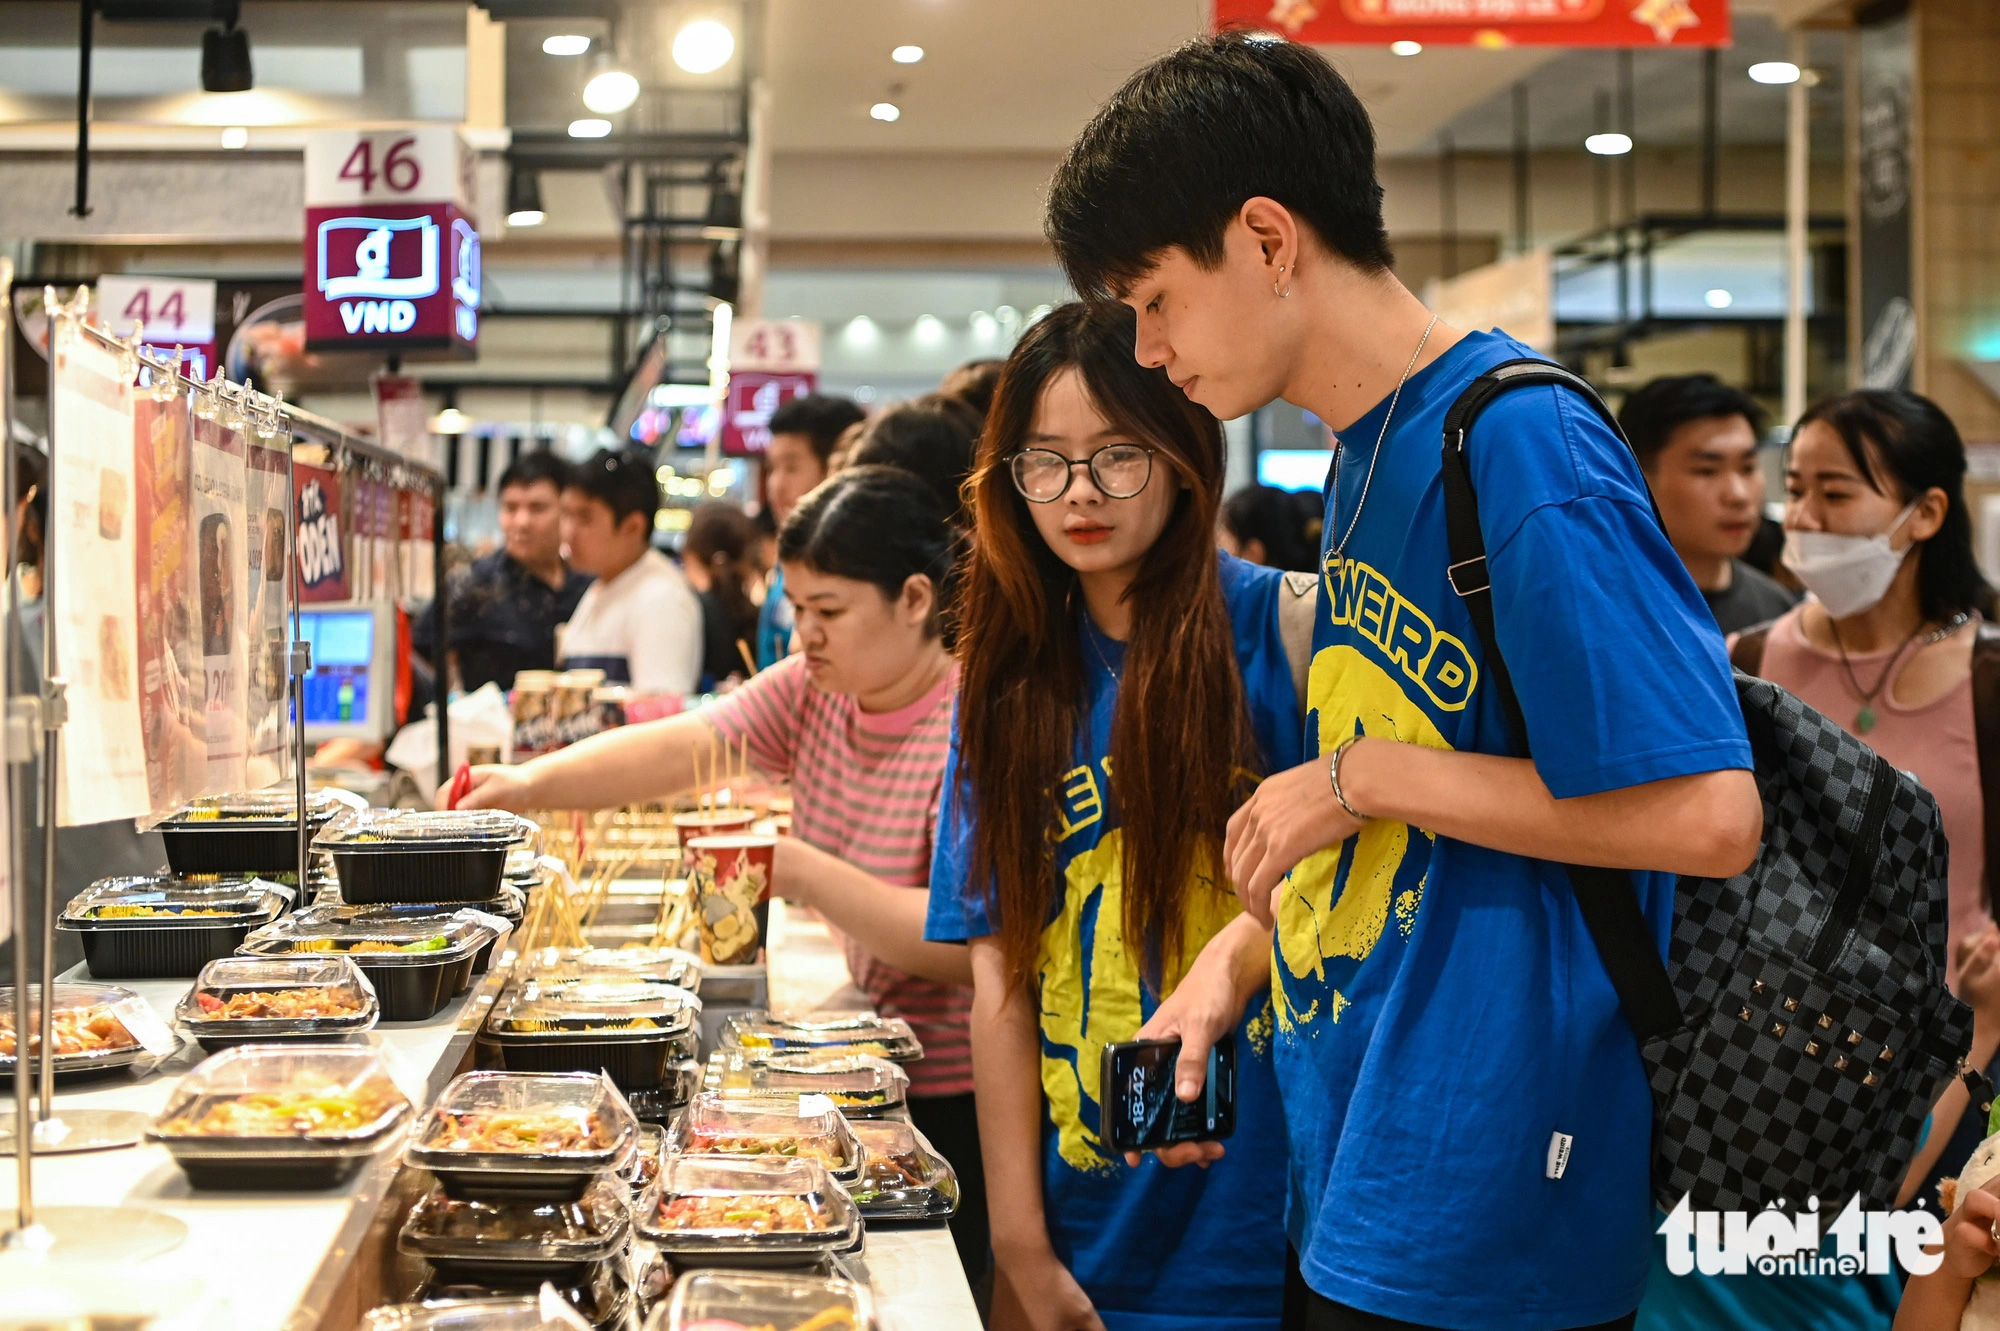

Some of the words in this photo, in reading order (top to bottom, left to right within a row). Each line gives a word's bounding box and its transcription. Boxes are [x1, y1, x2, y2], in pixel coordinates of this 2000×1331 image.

[338, 136, 421, 193] 46
[123, 287, 187, 330] 44
[339, 299, 417, 334] VND
[1324, 558, 1479, 712] WEIRD
[1132, 1065, 1145, 1128] 18:42
[1554, 1161, 1562, 1175] THE
[1557, 1136, 1567, 1160] WEIRD
